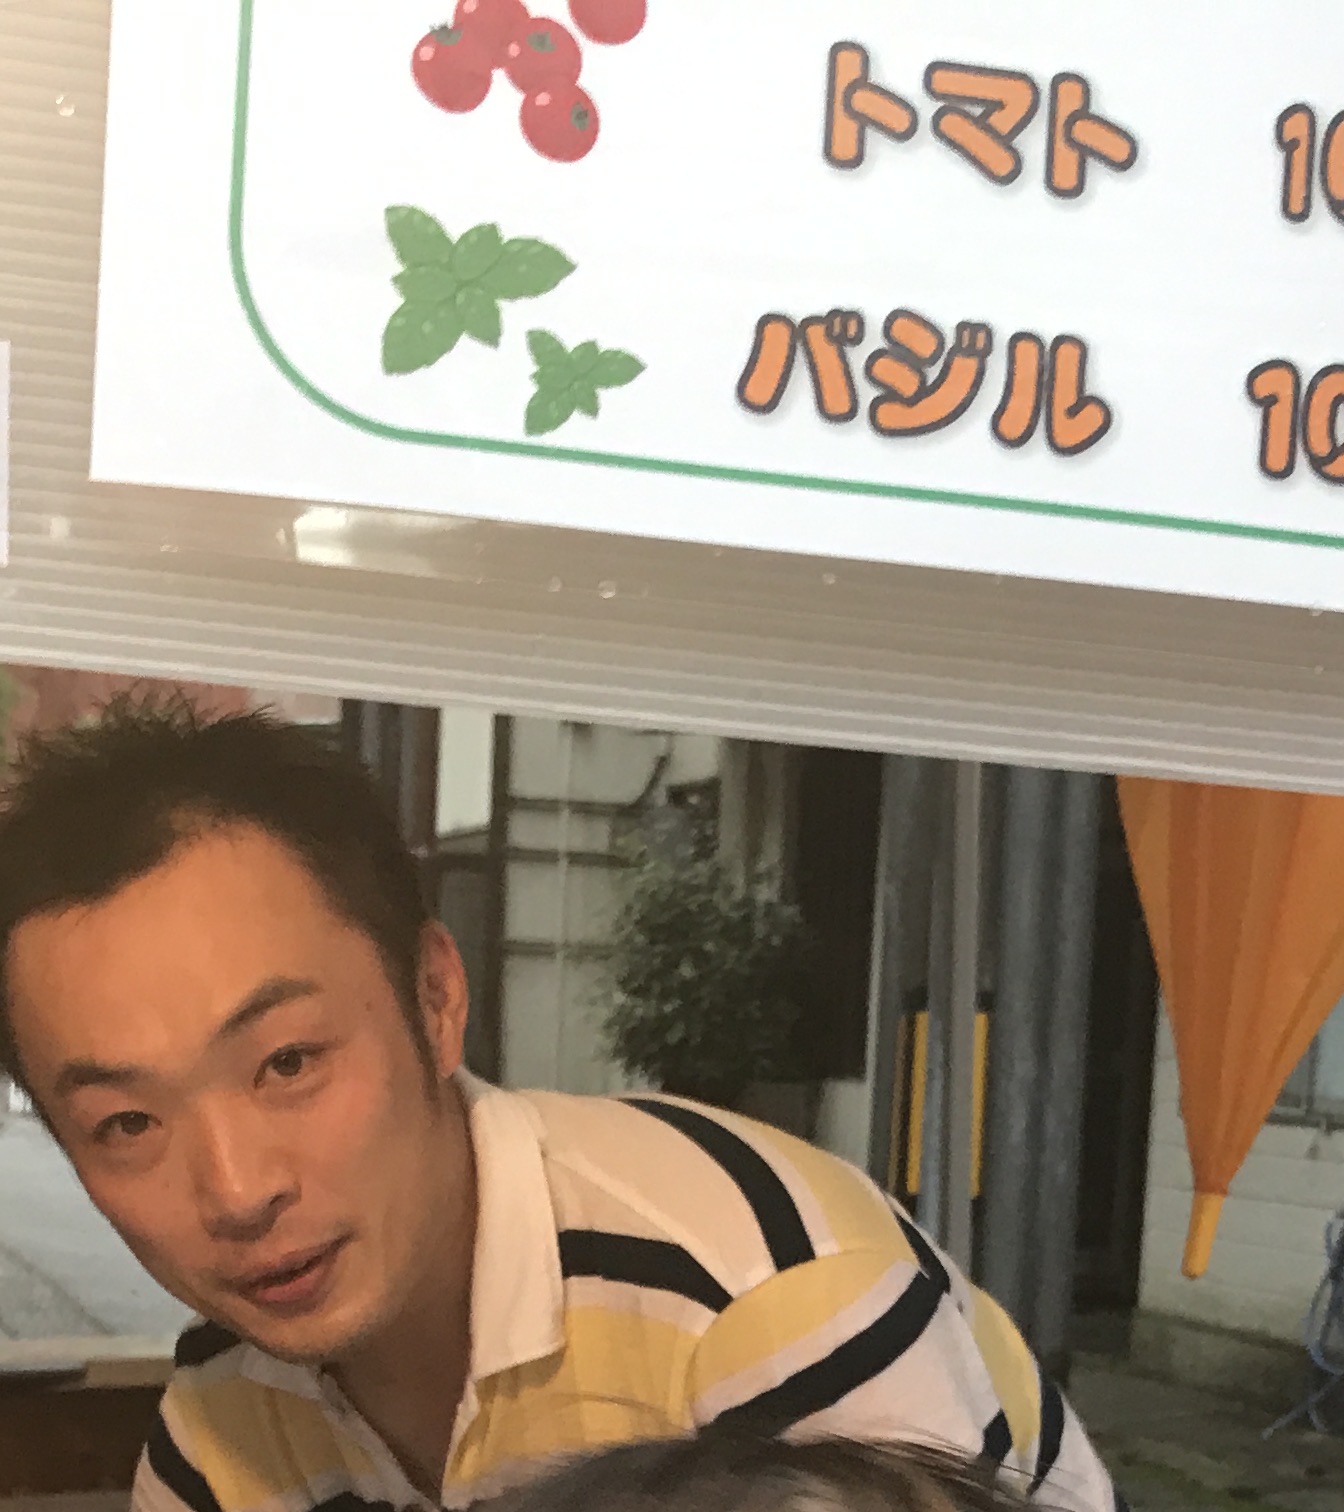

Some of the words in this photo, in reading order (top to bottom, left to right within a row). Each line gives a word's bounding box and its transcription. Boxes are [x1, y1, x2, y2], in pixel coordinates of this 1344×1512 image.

[822, 41, 1138, 200] トマト
[737, 309, 1113, 457] バジル
